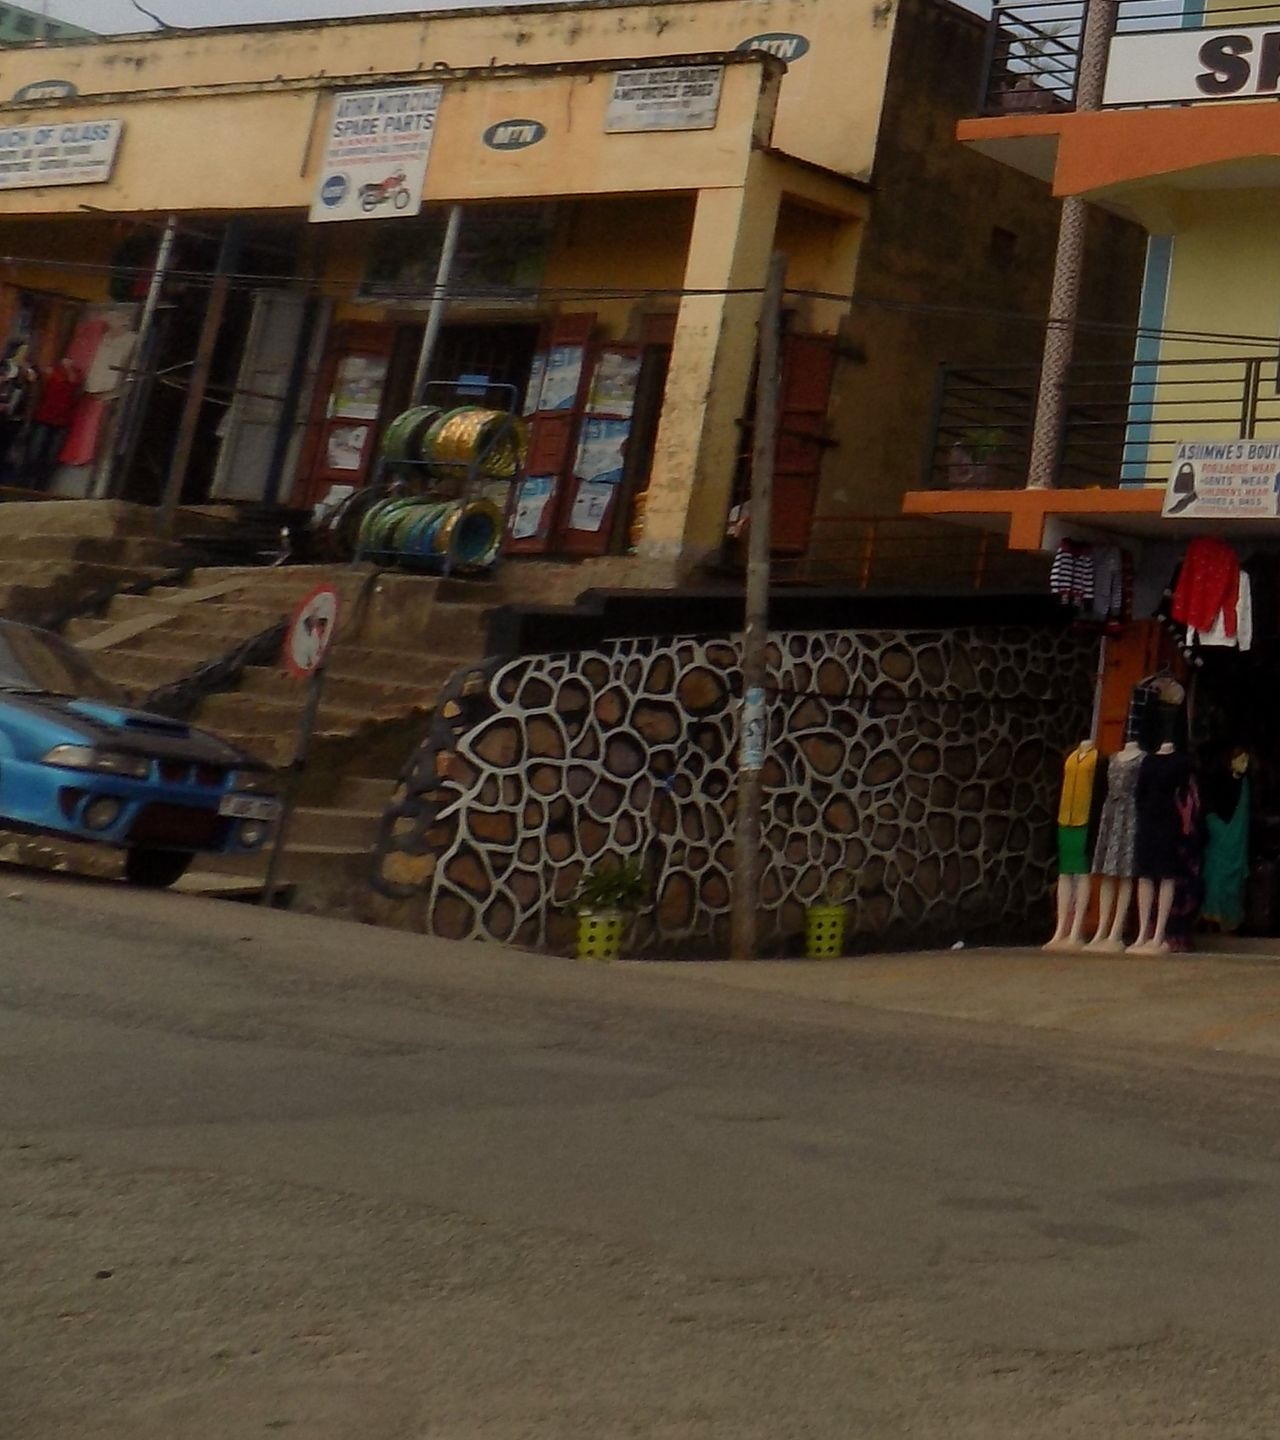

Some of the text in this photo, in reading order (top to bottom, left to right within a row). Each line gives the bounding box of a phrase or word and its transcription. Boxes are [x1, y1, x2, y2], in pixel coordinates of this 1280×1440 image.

[333, 113, 436, 138] SPARE PARTS
[492, 125, 538, 144] MTN
[1240, 475, 1270, 486] WEAR
